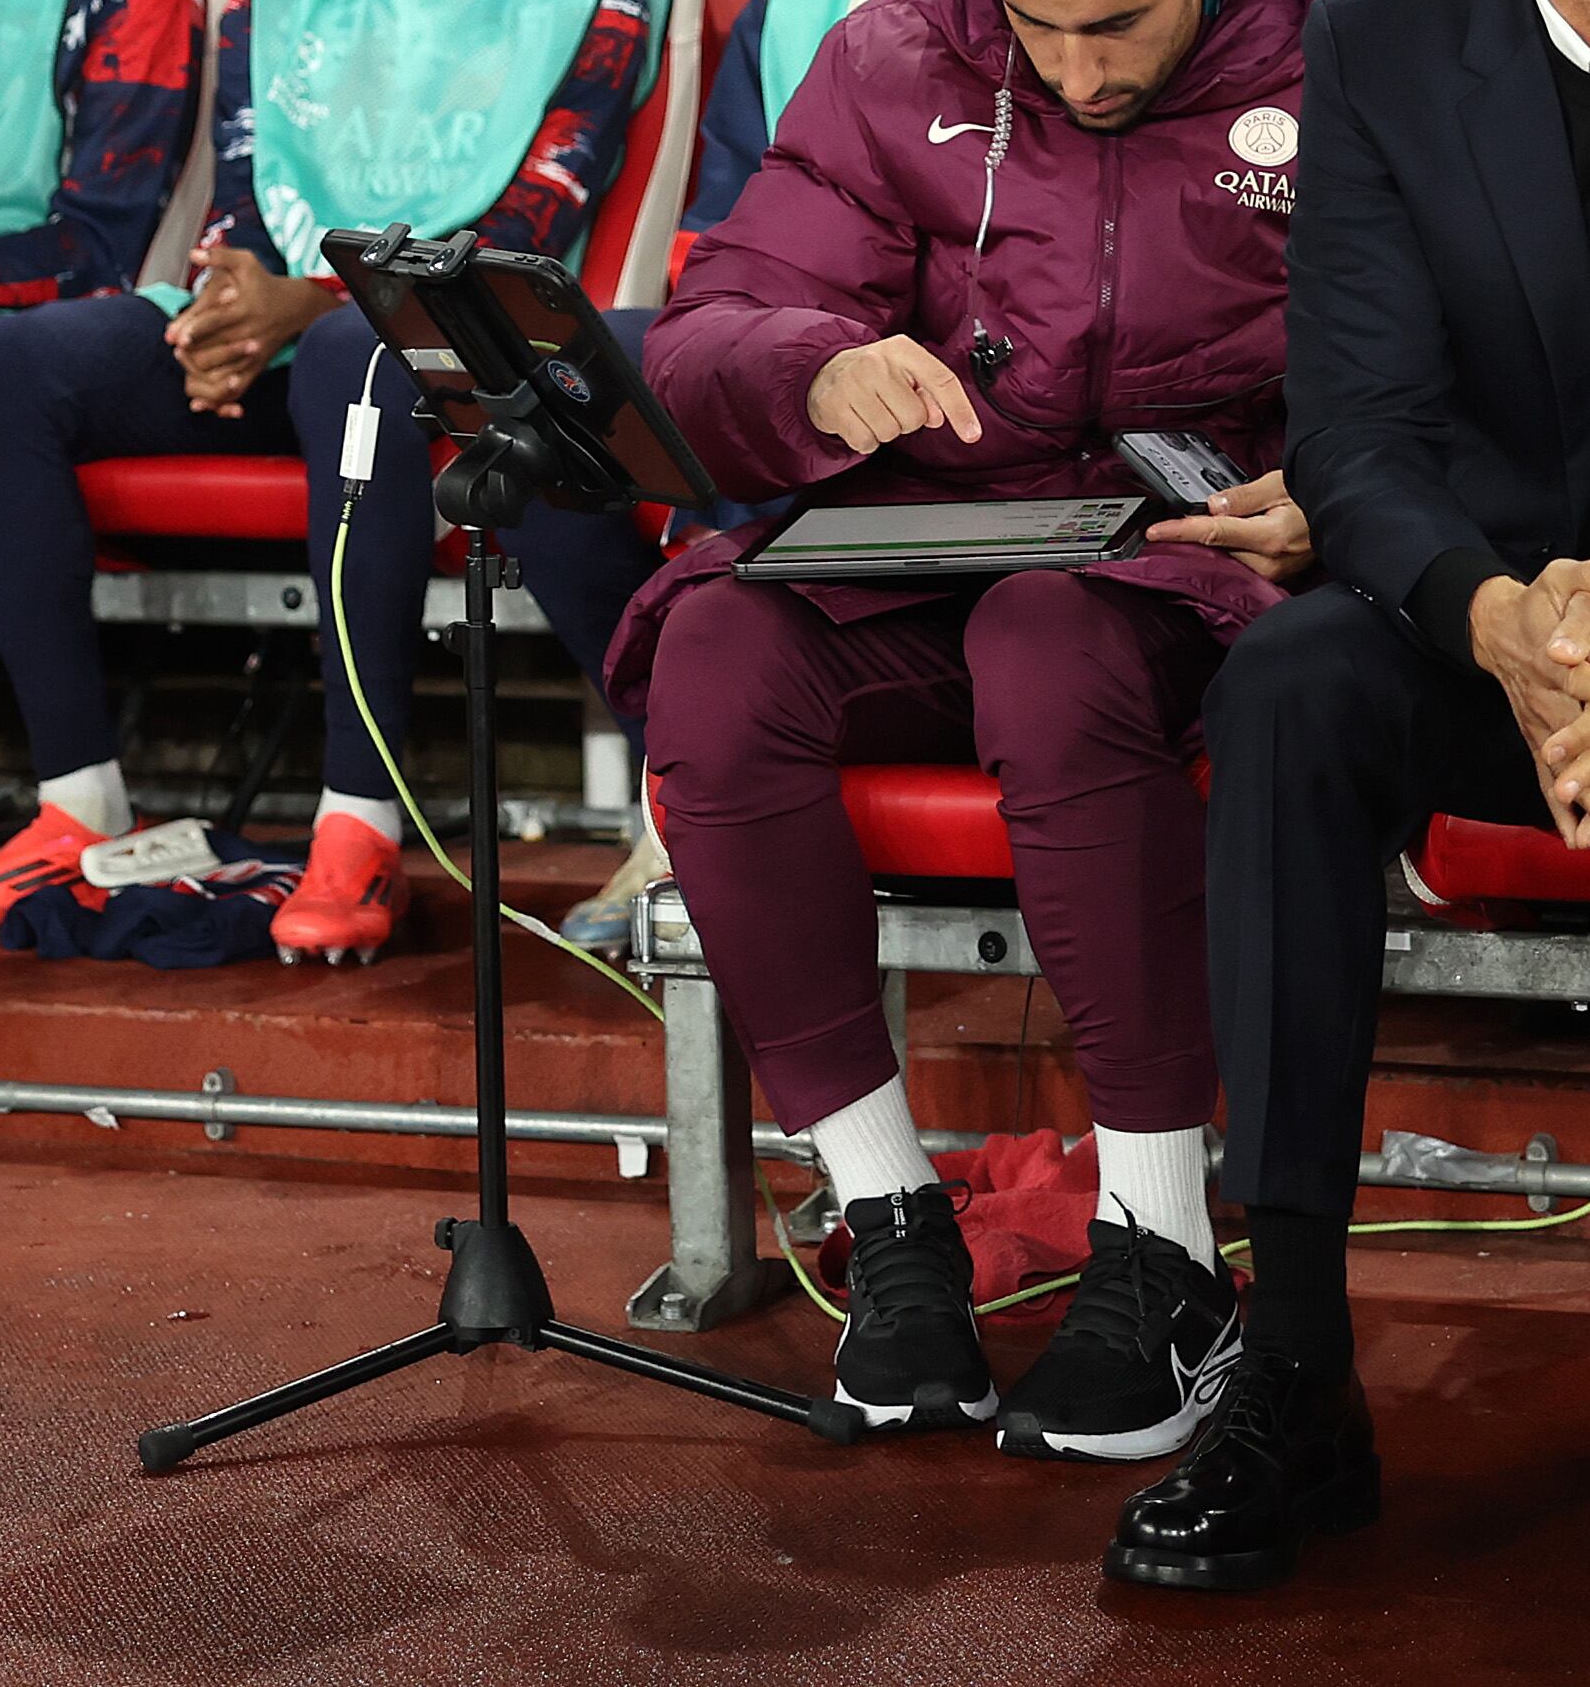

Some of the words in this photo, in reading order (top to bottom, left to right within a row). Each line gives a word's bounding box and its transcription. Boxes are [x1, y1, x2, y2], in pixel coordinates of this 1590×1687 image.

[1243, 113, 1286, 128] PARIS
[1214, 170, 1296, 200] QATA
[1237, 192, 1296, 214] AIRWAY
